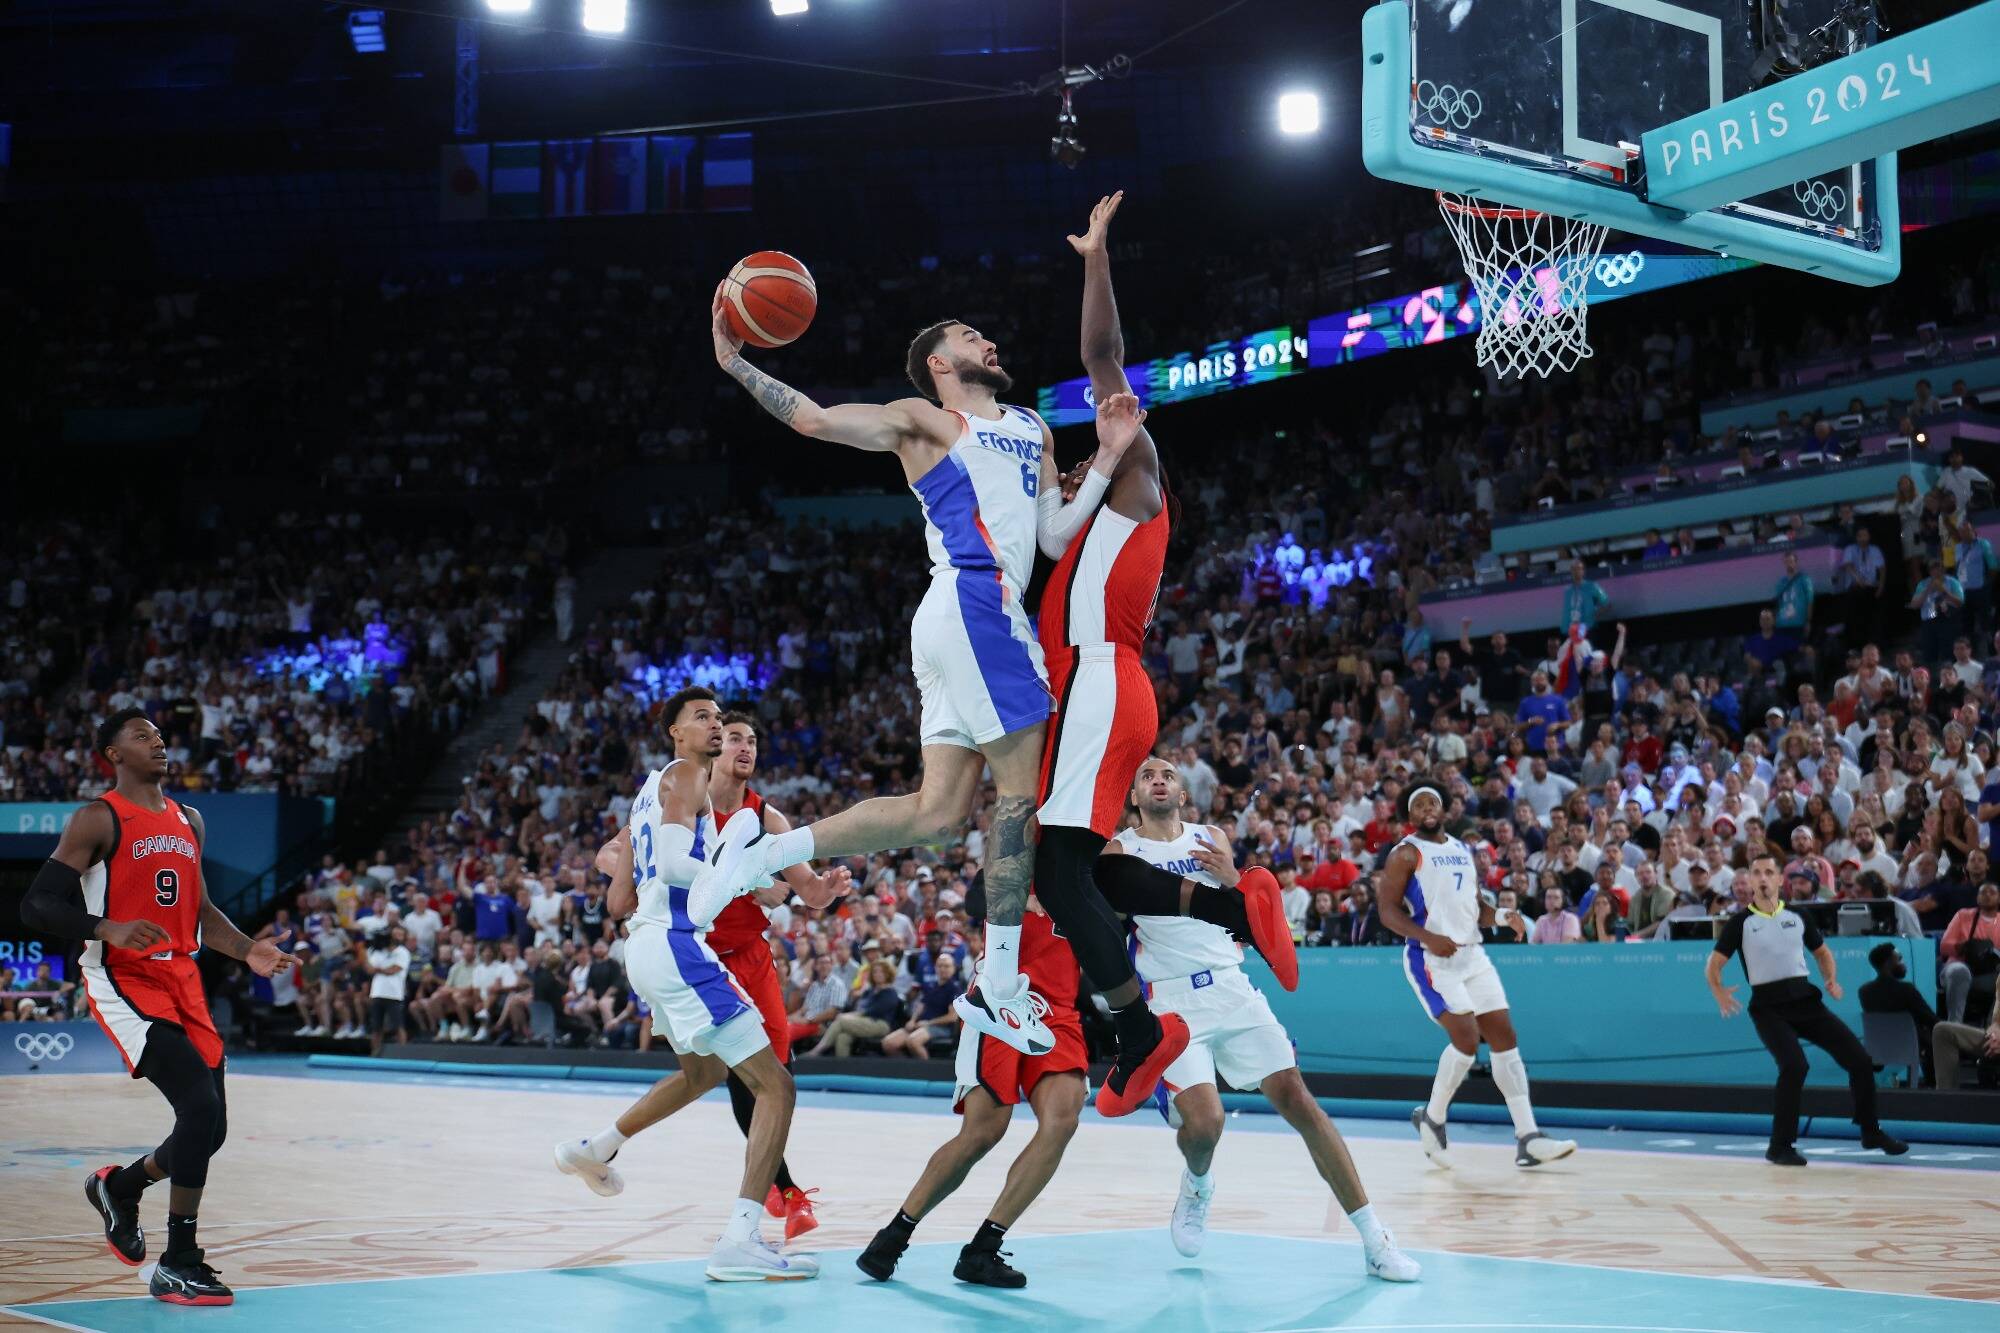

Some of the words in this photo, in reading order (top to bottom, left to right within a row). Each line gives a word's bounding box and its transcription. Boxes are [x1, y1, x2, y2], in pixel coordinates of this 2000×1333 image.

[1806, 53, 1932, 126] 2024
[1242, 335, 1309, 373] 2024
[976, 431, 1042, 463] FRANC
[1020, 462, 1038, 498] 6
[132, 834, 197, 864] CANADA
[154, 868, 179, 907] 9
[1452, 872, 1463, 891] 7
